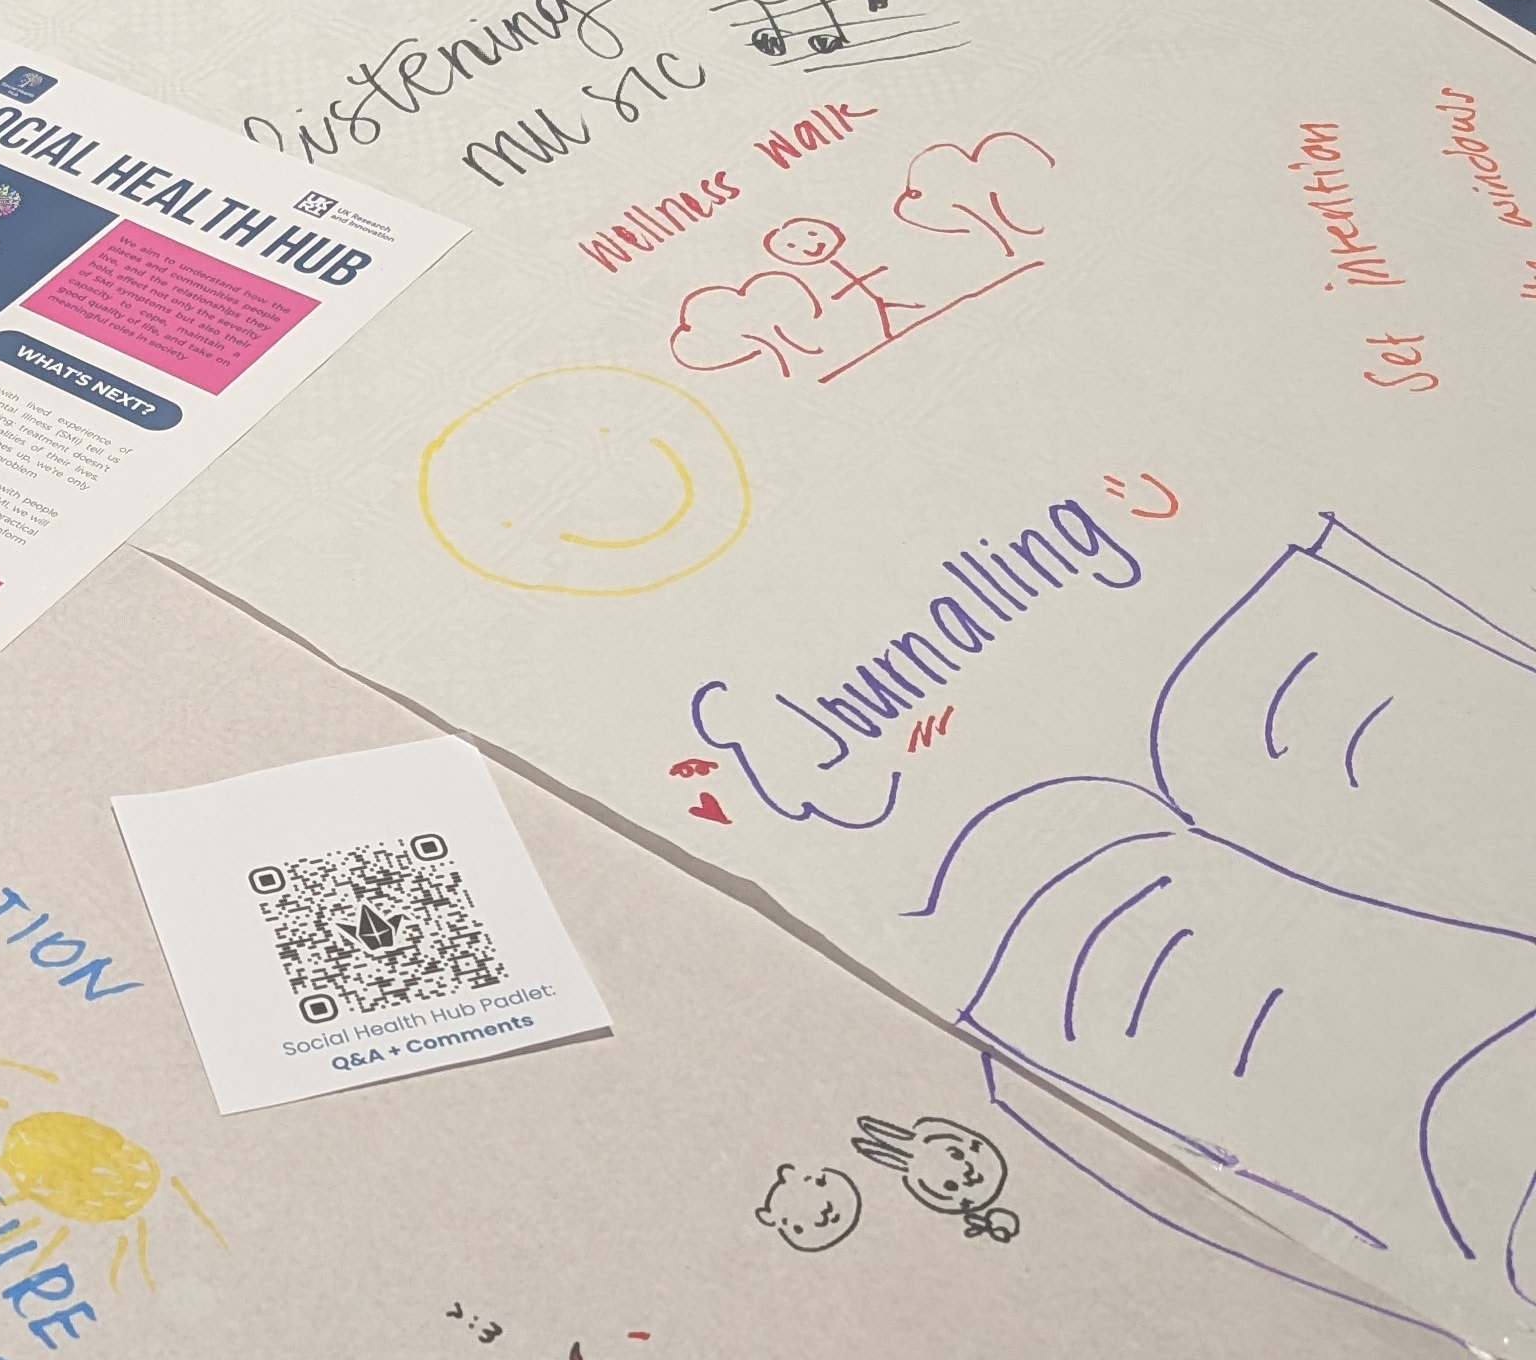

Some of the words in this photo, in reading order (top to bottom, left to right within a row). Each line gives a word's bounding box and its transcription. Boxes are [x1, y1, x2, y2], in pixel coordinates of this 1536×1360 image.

[462, 49, 707, 187] music
[91, 154, 278, 247] HEALTH
[260, 225, 372, 286] HUB
[330, 214, 349, 224] and
[348, 220, 395, 242] Innovation
[337, 207, 352, 217] UK
[350, 213, 391, 233] Research
[120, 236, 137, 248] We
[140, 247, 160, 258] aim
[161, 255, 179, 266] to
[178, 264, 242, 293] understand
[243, 290, 267, 304] how
[271, 302, 291, 314] the
[17, 345, 92, 386] WHAT'S
[91, 381, 156, 415] NEXT?
[1364, 332, 1440, 393] Set
[775, 496, 1143, 770] Journalling
[282, 1028, 350, 1057] Social
[353, 1012, 427, 1040] Health
[430, 1002, 476, 1024] Hub
[479, 983, 557, 1013] Padlet:
[331, 1047, 385, 1071] Q&A
[388, 1046, 401, 1056] +
[405, 1015, 534, 1054] Comments
